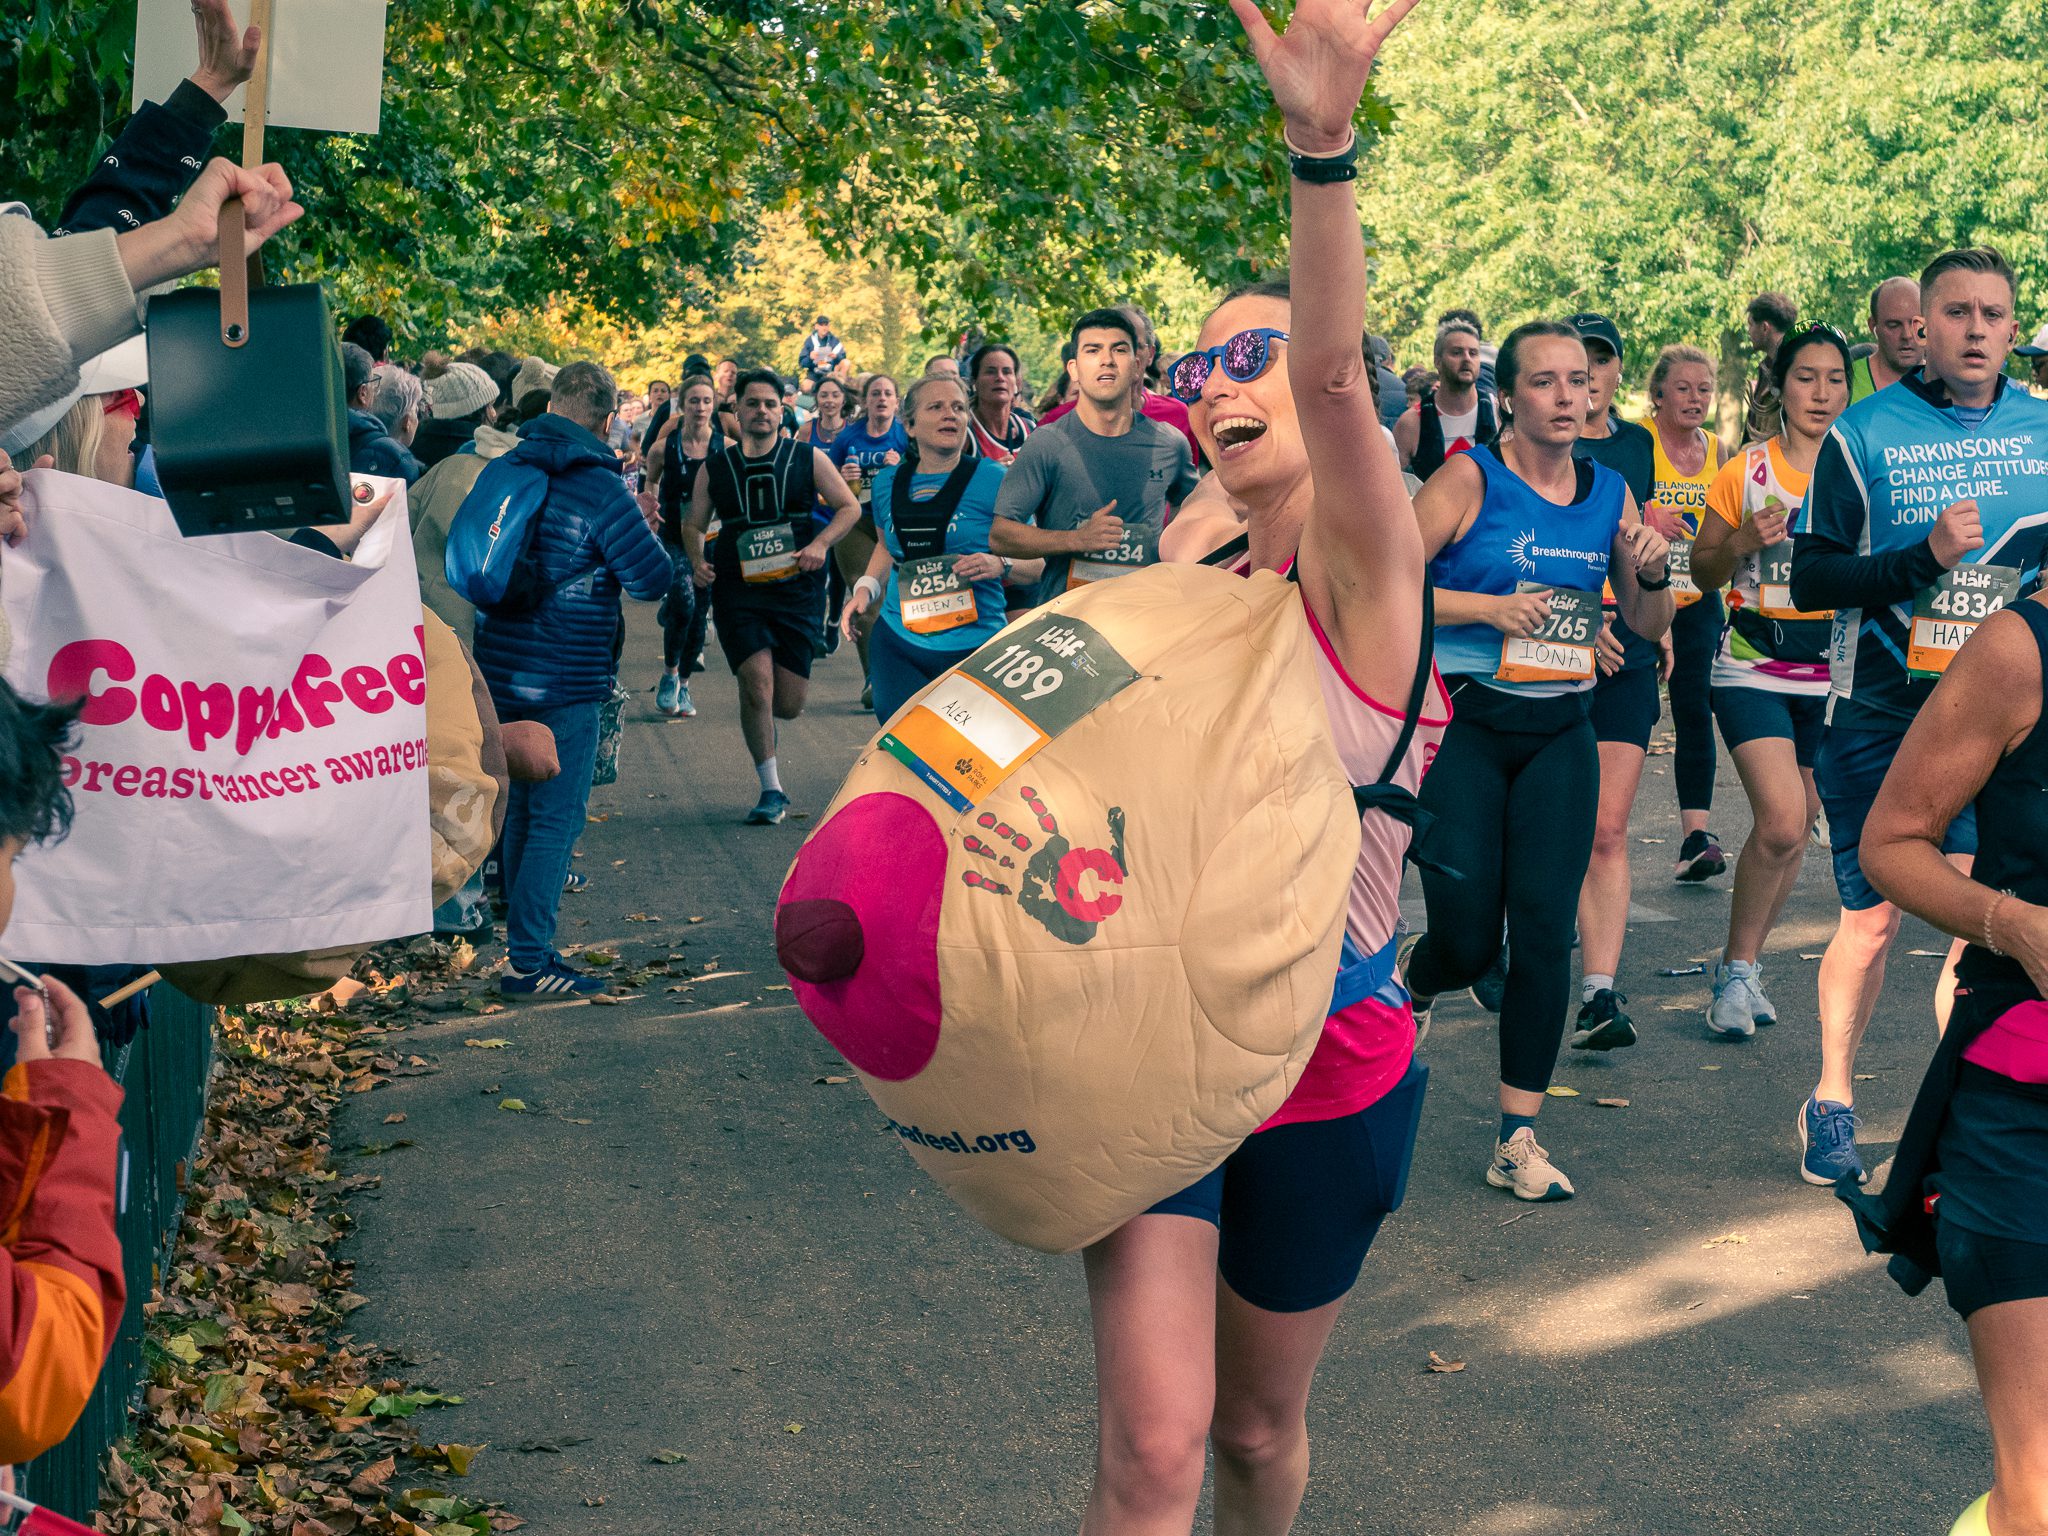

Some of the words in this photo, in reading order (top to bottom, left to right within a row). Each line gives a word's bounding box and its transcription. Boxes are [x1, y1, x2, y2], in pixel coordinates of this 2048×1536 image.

[860, 452, 886, 465] UC
[1884, 437, 2024, 466] PARKINSON'S
[1653, 481, 1706, 491] ELANOMA
[1888, 463, 1968, 487] CHANGE
[1890, 485, 1937, 507] FIND
[1940, 484, 1953, 501] A
[1955, 480, 2009, 499] CURE.
[1891, 504, 1938, 526] JOIN
[749, 539, 784, 557] 1765
[1532, 546, 1598, 563] Breakthrough
[916, 561, 943, 575] Half
[1952, 570, 1992, 589] Half
[910, 573, 959, 597] 6254
[911, 599, 950, 615] HELEN
[1546, 595, 1580, 611] Half
[1930, 590, 2004, 619] 4834
[1034, 625, 1085, 658] Half
[1518, 641, 1582, 668] IONA
[983, 644, 1064, 701] 1189
[941, 700, 972, 726] ALEX
[212, 760, 321, 803] cancer
[324, 737, 429, 785] awarene
[973, 768, 989, 785] ROYAL
